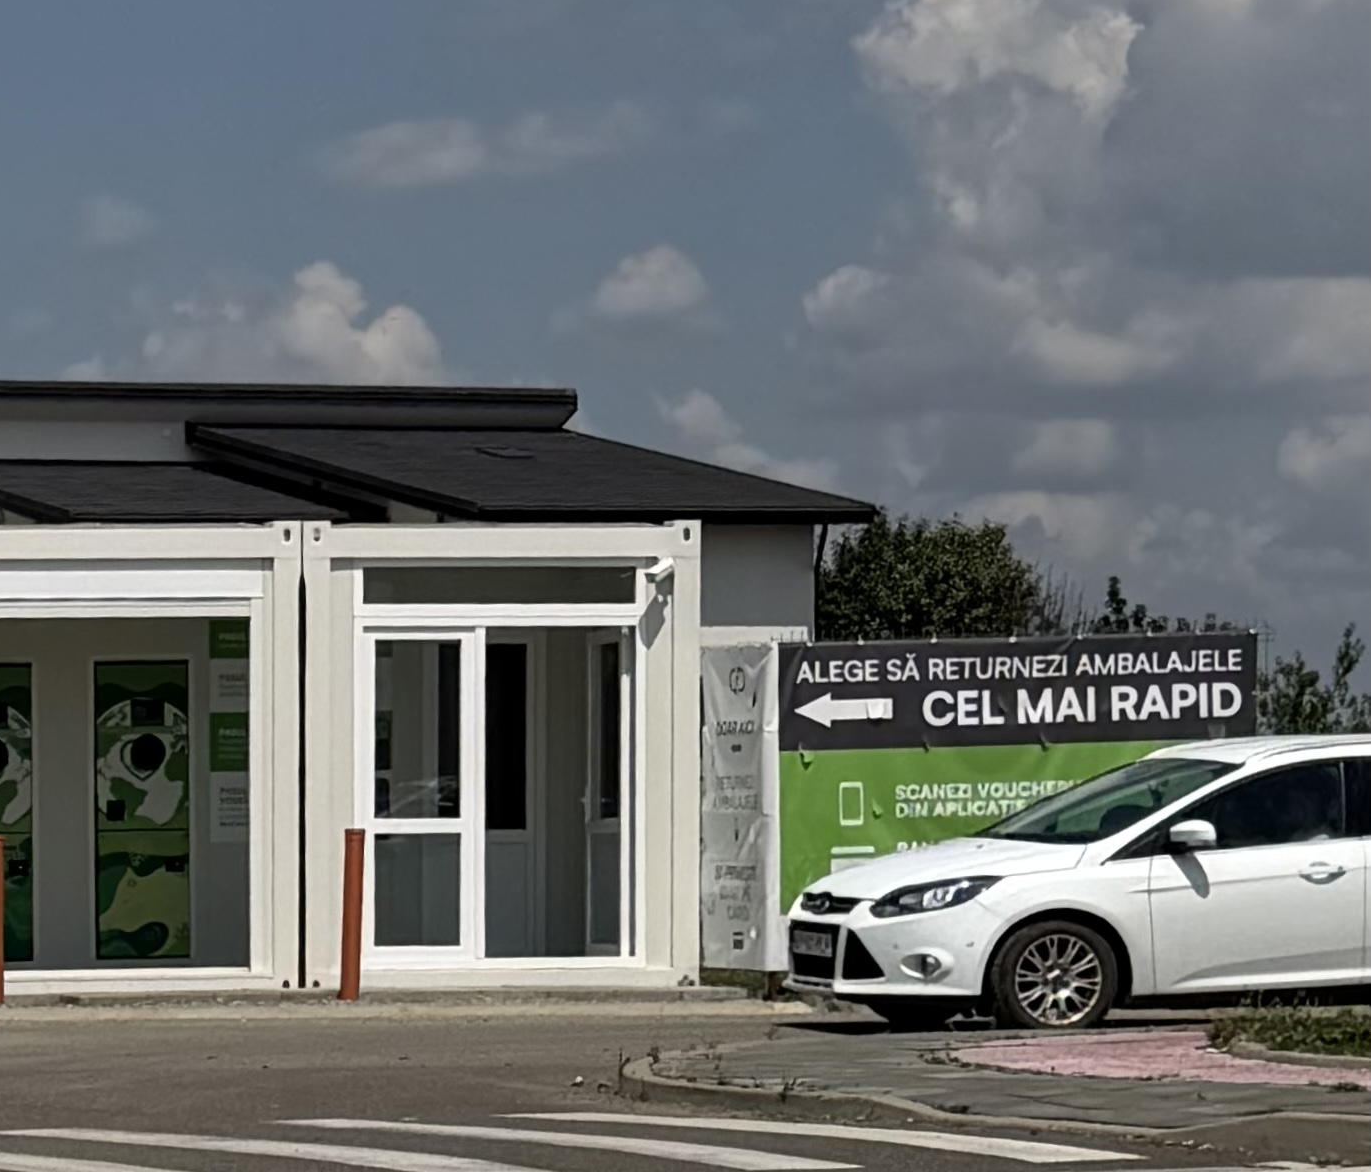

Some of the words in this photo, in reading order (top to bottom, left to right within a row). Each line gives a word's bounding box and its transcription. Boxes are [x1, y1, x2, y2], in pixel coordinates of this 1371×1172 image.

[796, 660, 880, 684] ALEGE
[886, 653, 920, 681] SĂ
[928, 655, 1068, 680] RETURNEZI
[1075, 649, 1242, 676] AMBALAJELE
[922, 690, 1005, 727] CEL
[1017, 686, 1096, 724] MAI
[1111, 682, 1242, 721] RAPID
[895, 783, 972, 801] SCANEZI
[895, 802, 928, 819] DIN
